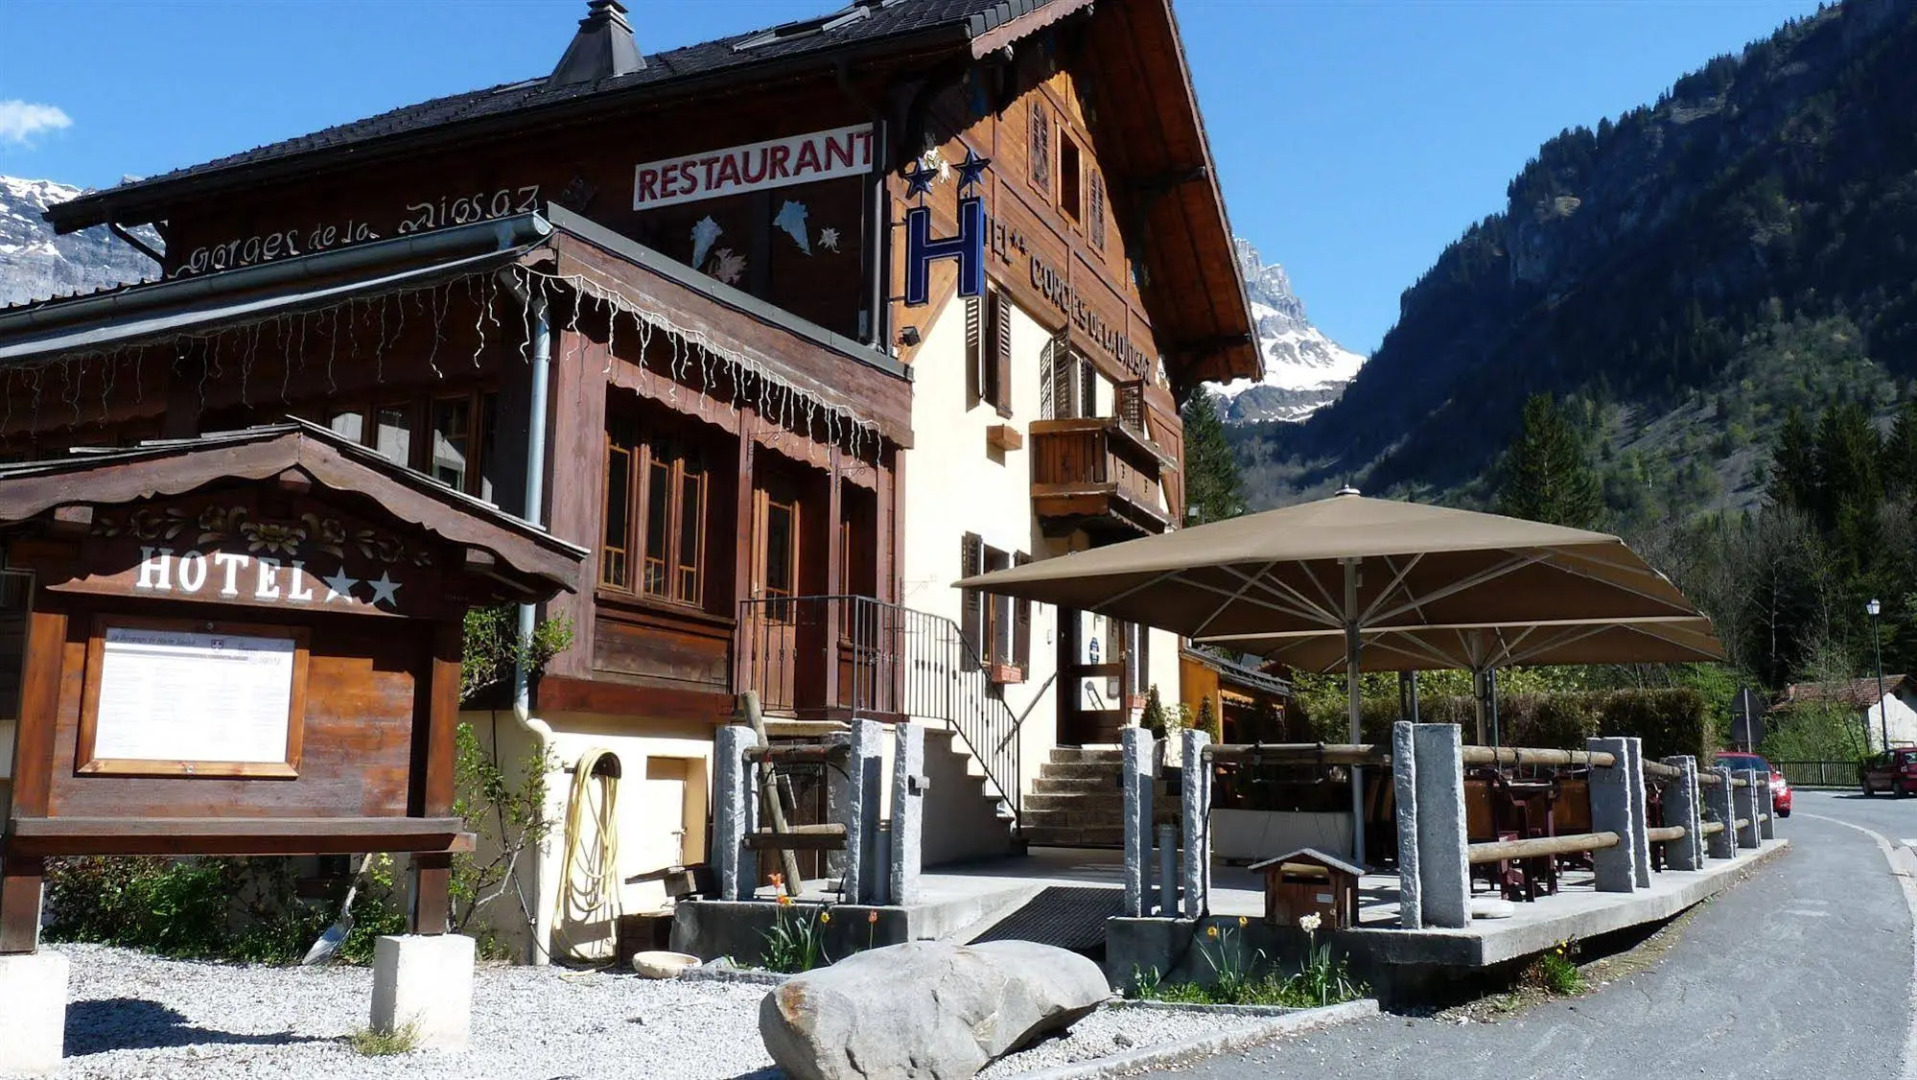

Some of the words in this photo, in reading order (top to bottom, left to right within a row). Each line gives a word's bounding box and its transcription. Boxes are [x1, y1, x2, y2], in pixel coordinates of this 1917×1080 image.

[638, 130, 873, 203] RESTAURANT
[905, 196, 985, 307] H
[136, 545, 314, 601] HOTEL
